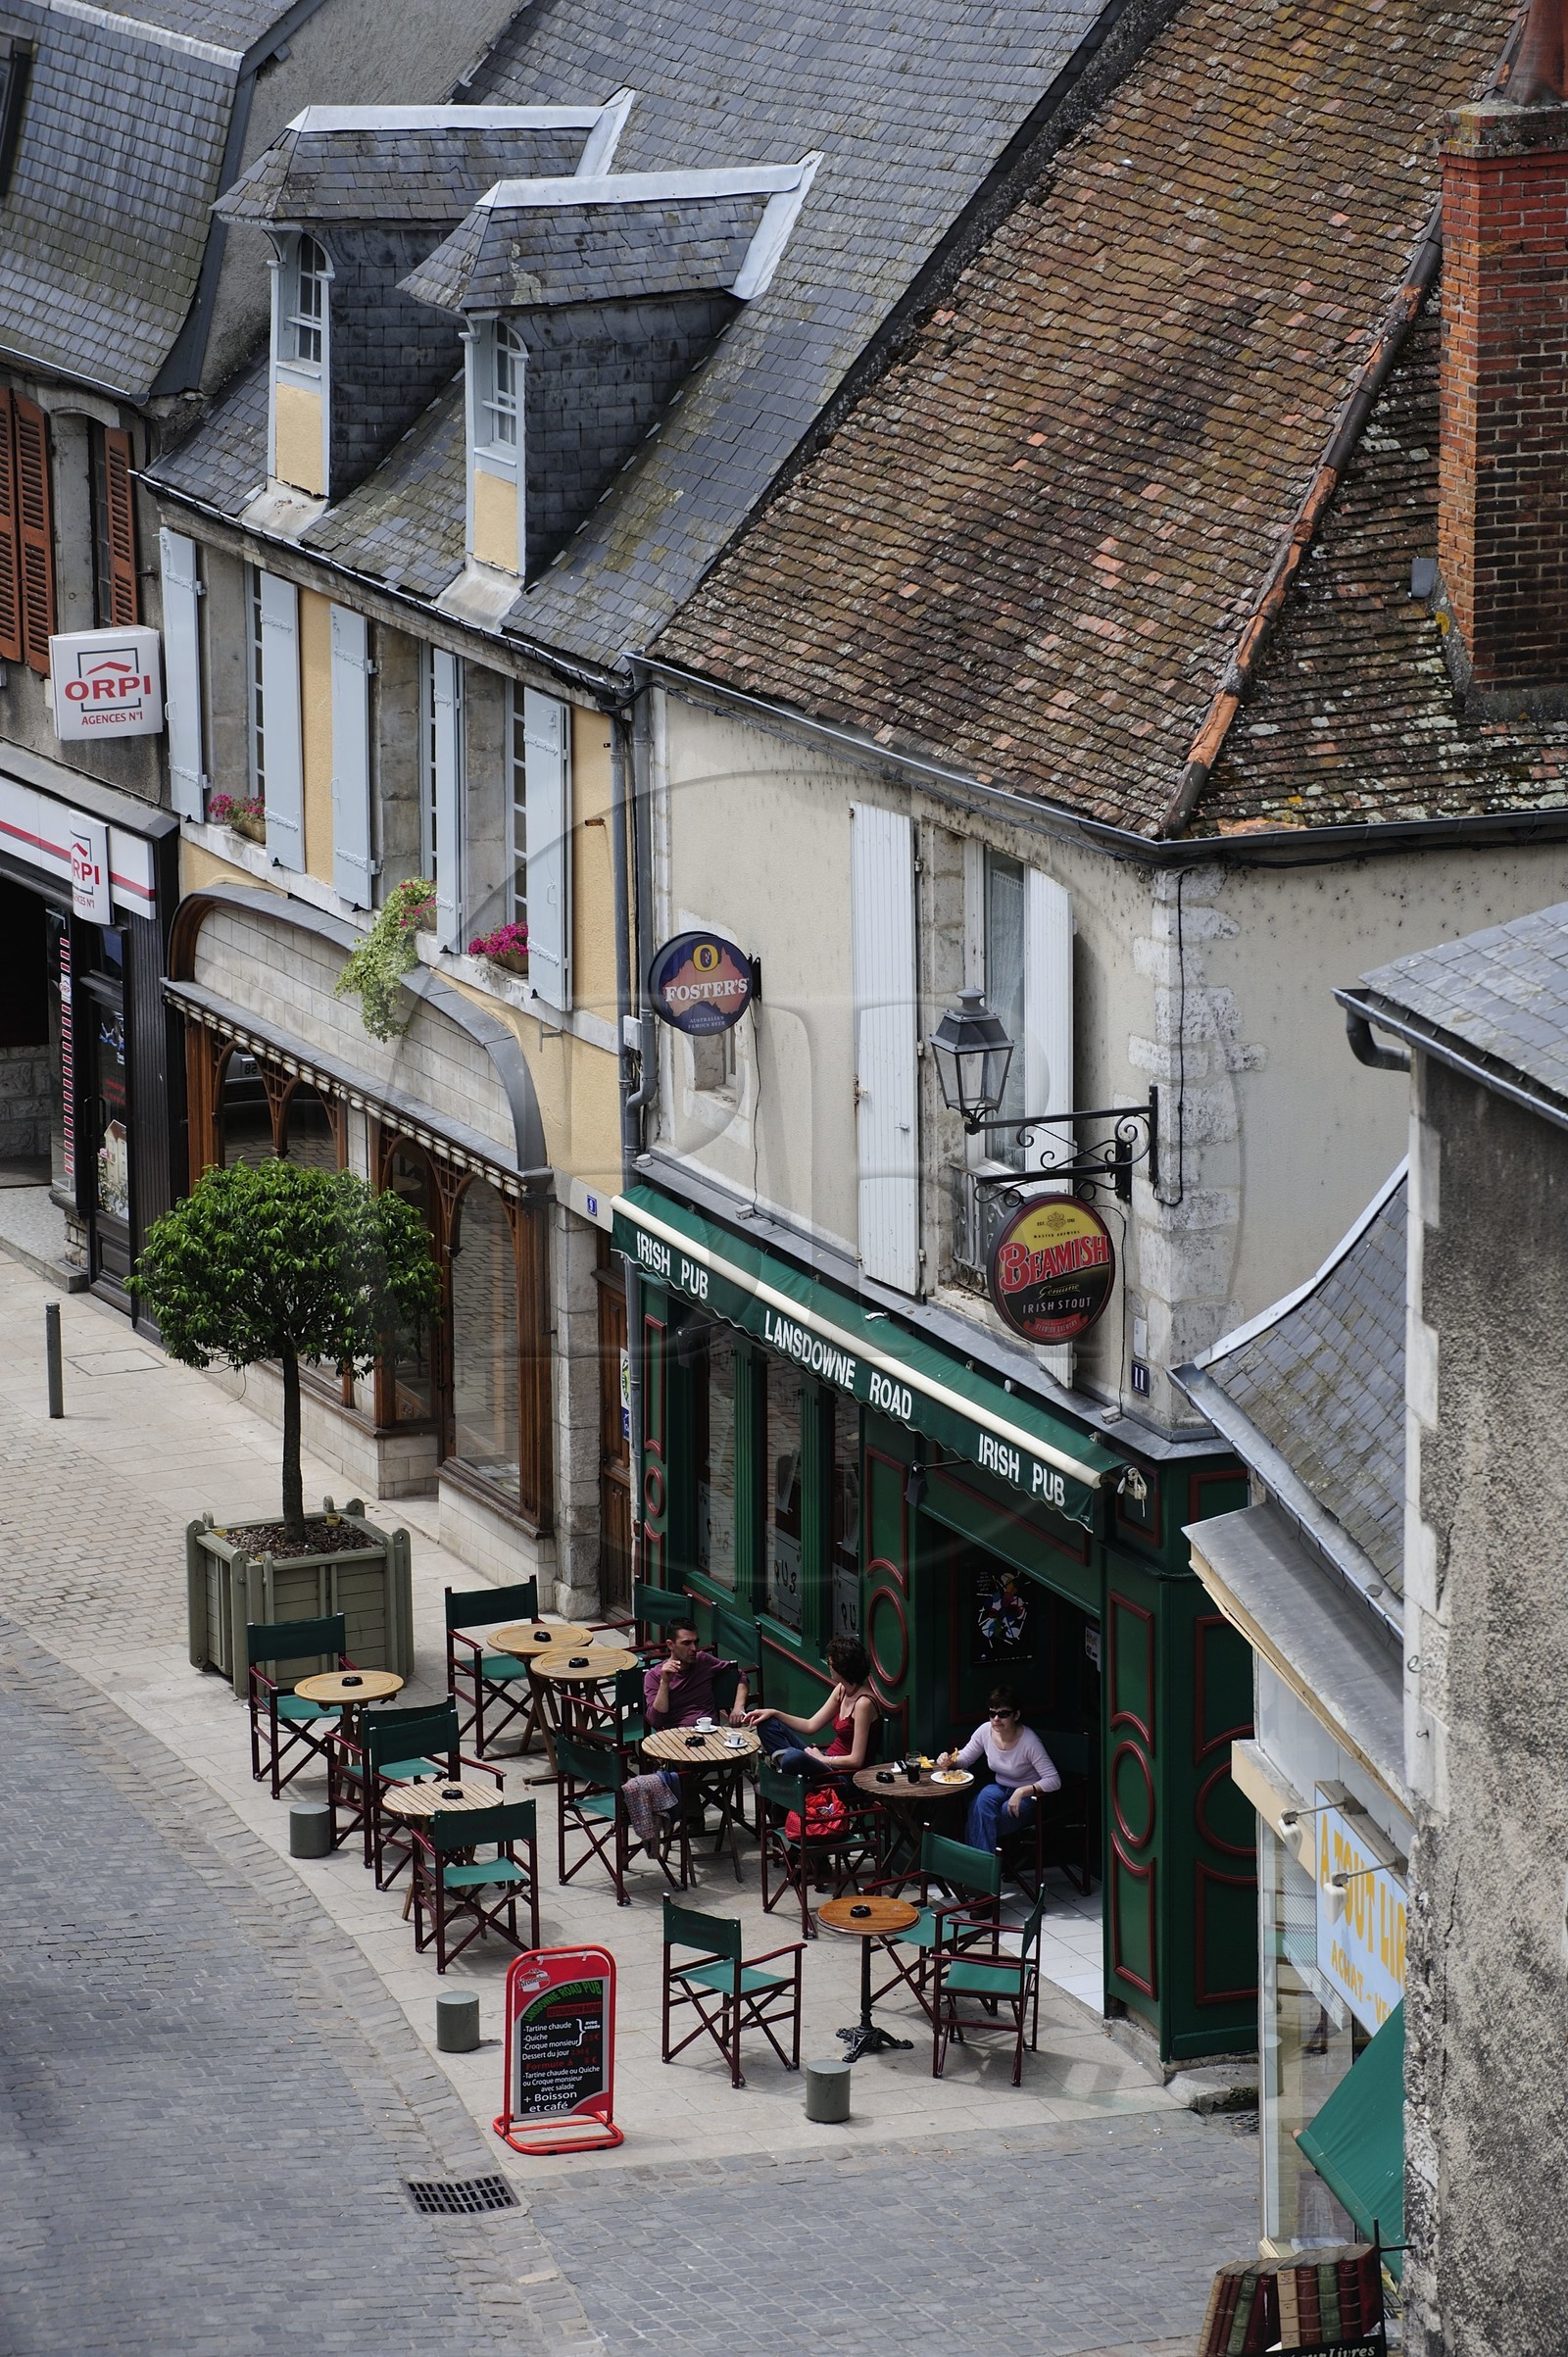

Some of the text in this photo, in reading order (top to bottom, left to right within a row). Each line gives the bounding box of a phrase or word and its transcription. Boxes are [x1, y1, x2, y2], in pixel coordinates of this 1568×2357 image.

[65, 675, 151, 701] ORPI
[81, 712, 126, 725] AGENCES
[73, 858, 99, 885] RPI
[665, 978, 749, 1002] FOSTER'S
[690, 1015, 724, 1024] AUSTRALIA'S
[589, 1200, 594, 1211] 9
[637, 1231, 709, 1300] IRISH PUB
[999, 1235, 1109, 1293] BEAMISH
[1036, 1283, 1080, 1300] Genuine
[1022, 1297, 1092, 1314] IRISH STOUT
[764, 1310, 912, 1420] LANSDOWNE ROAD
[1134, 1366, 1146, 1391] 11
[978, 1433, 1065, 1507] IRISH PUB
[1380, 1882, 1406, 1991] LIR
[1332, 1940, 1364, 2003] ACHAT
[1375, 1992, 1392, 2025] VE
[522, 1982, 602, 2022] LANSDOWNE ROAD PUB
[549, 2039, 578, 2048] monsieur
[556, 2049, 569, 2059] jour
[526, 2062, 564, 2071] Formule
[532, 2077, 554, 2086] Croque
[555, 2075, 583, 2084] monsieur
[534, 2091, 577, 2102] Boisson
[529, 2101, 568, 2113] et café
